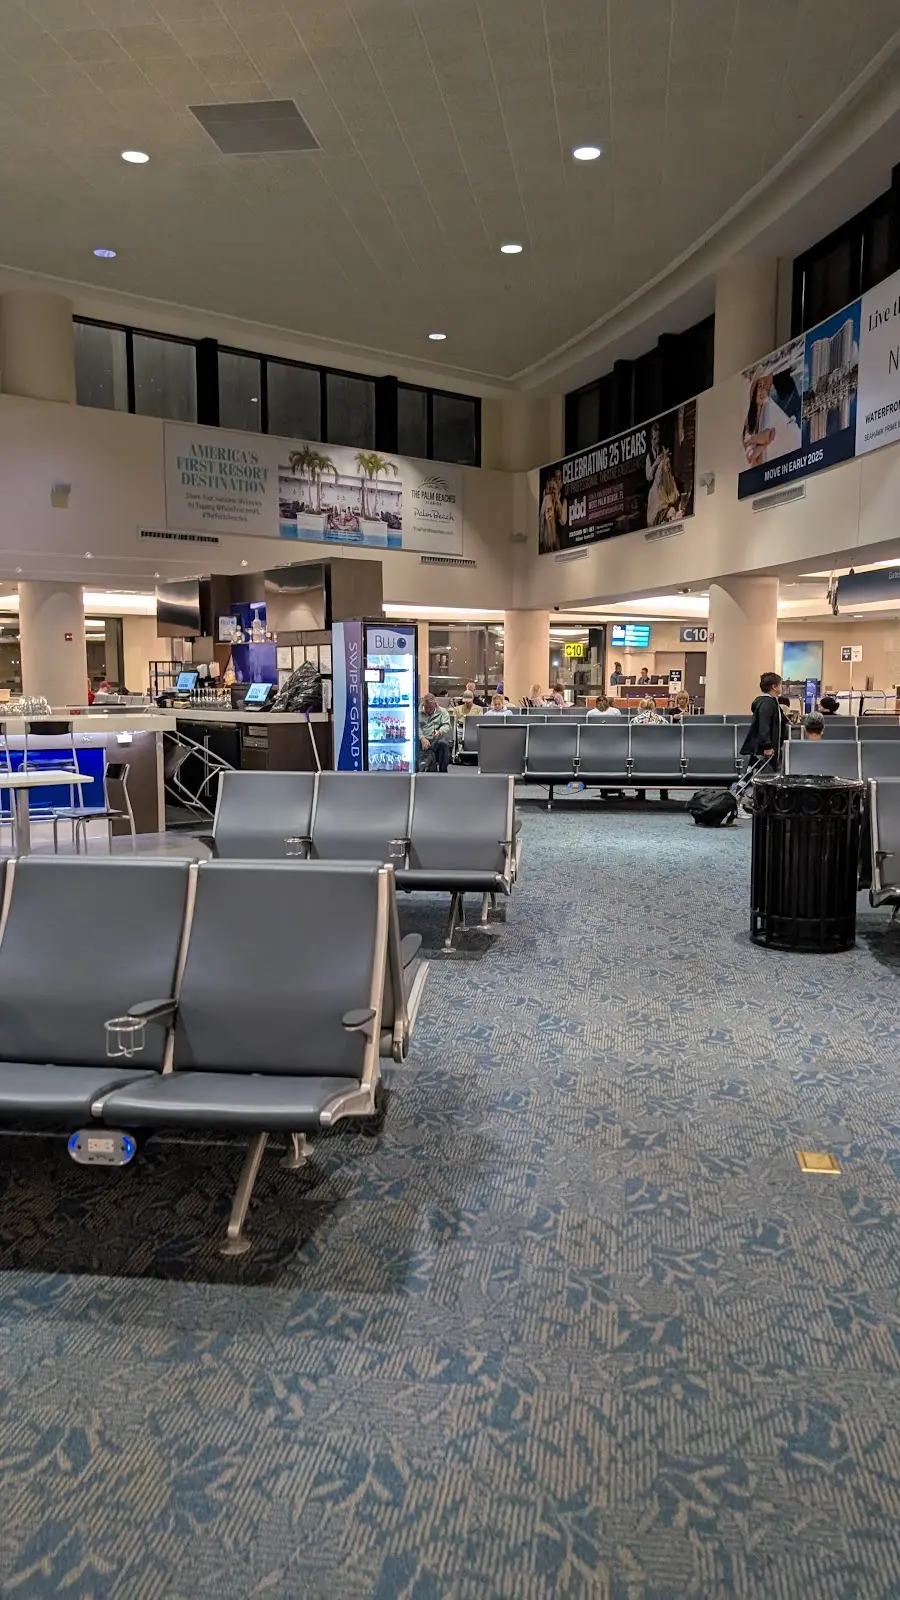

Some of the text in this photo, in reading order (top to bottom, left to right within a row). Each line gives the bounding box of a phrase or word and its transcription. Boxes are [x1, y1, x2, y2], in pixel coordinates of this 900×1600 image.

[868, 308, 891, 332] Live
[190, 443, 260, 465] AMERICA'S
[562, 430, 647, 485] CELEBRATING 25 YEARS
[764, 449, 824, 482] MOVE IN EARLY 2025
[175, 456, 269, 483] FIRST RESORT
[181, 471, 267, 495] DESTINATION
[411, 489, 456, 504] THE PALM BEACHES
[412, 507, 432, 518] Palm
[431, 509, 455, 521] Beach
[568, 495, 587, 527] pbd
[375, 634, 395, 649] BLU
[683, 628, 707, 641] C10
[565, 645, 582, 656] C10
[348, 641, 360, 757] SWIPE GRAB
